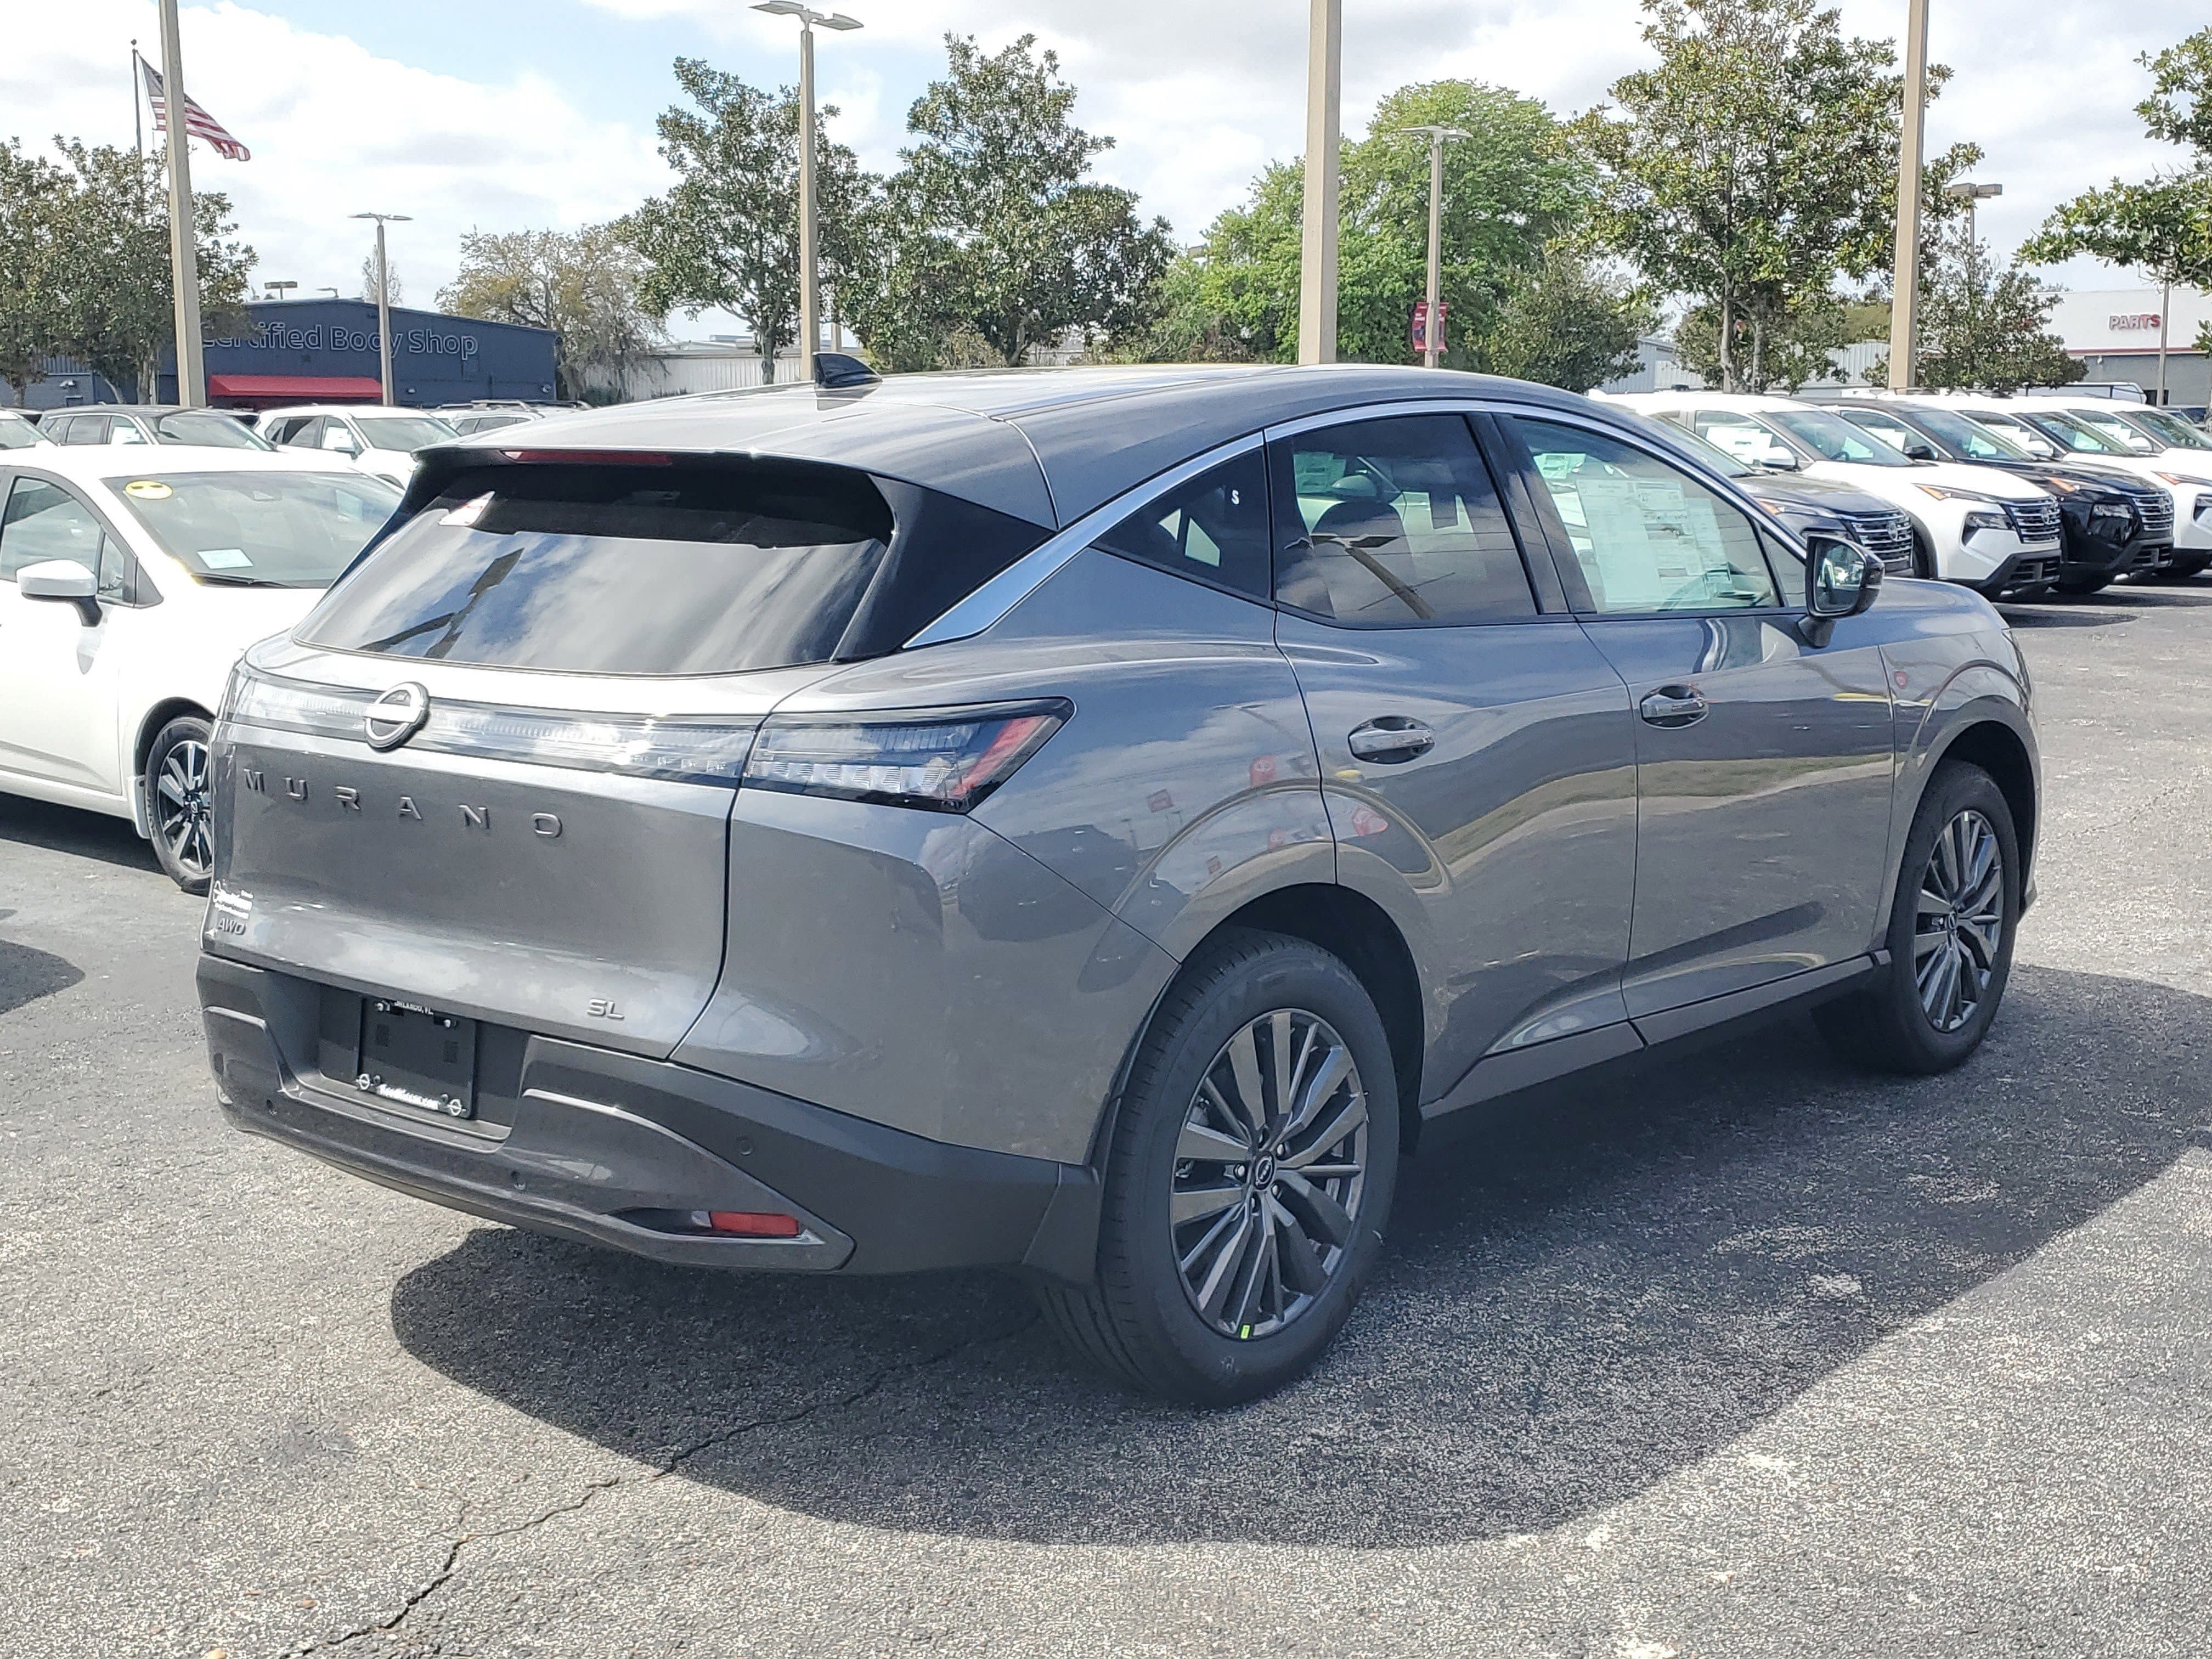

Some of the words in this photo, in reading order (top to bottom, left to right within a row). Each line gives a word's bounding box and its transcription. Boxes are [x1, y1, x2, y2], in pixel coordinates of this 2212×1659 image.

[2109, 314, 2161, 330] PARTS
[200, 321, 323, 350] eified
[408, 329, 478, 360] Shop
[243, 768, 563, 838] MURANO
[218, 918, 246, 935] AWD
[586, 998, 625, 1020] SL
